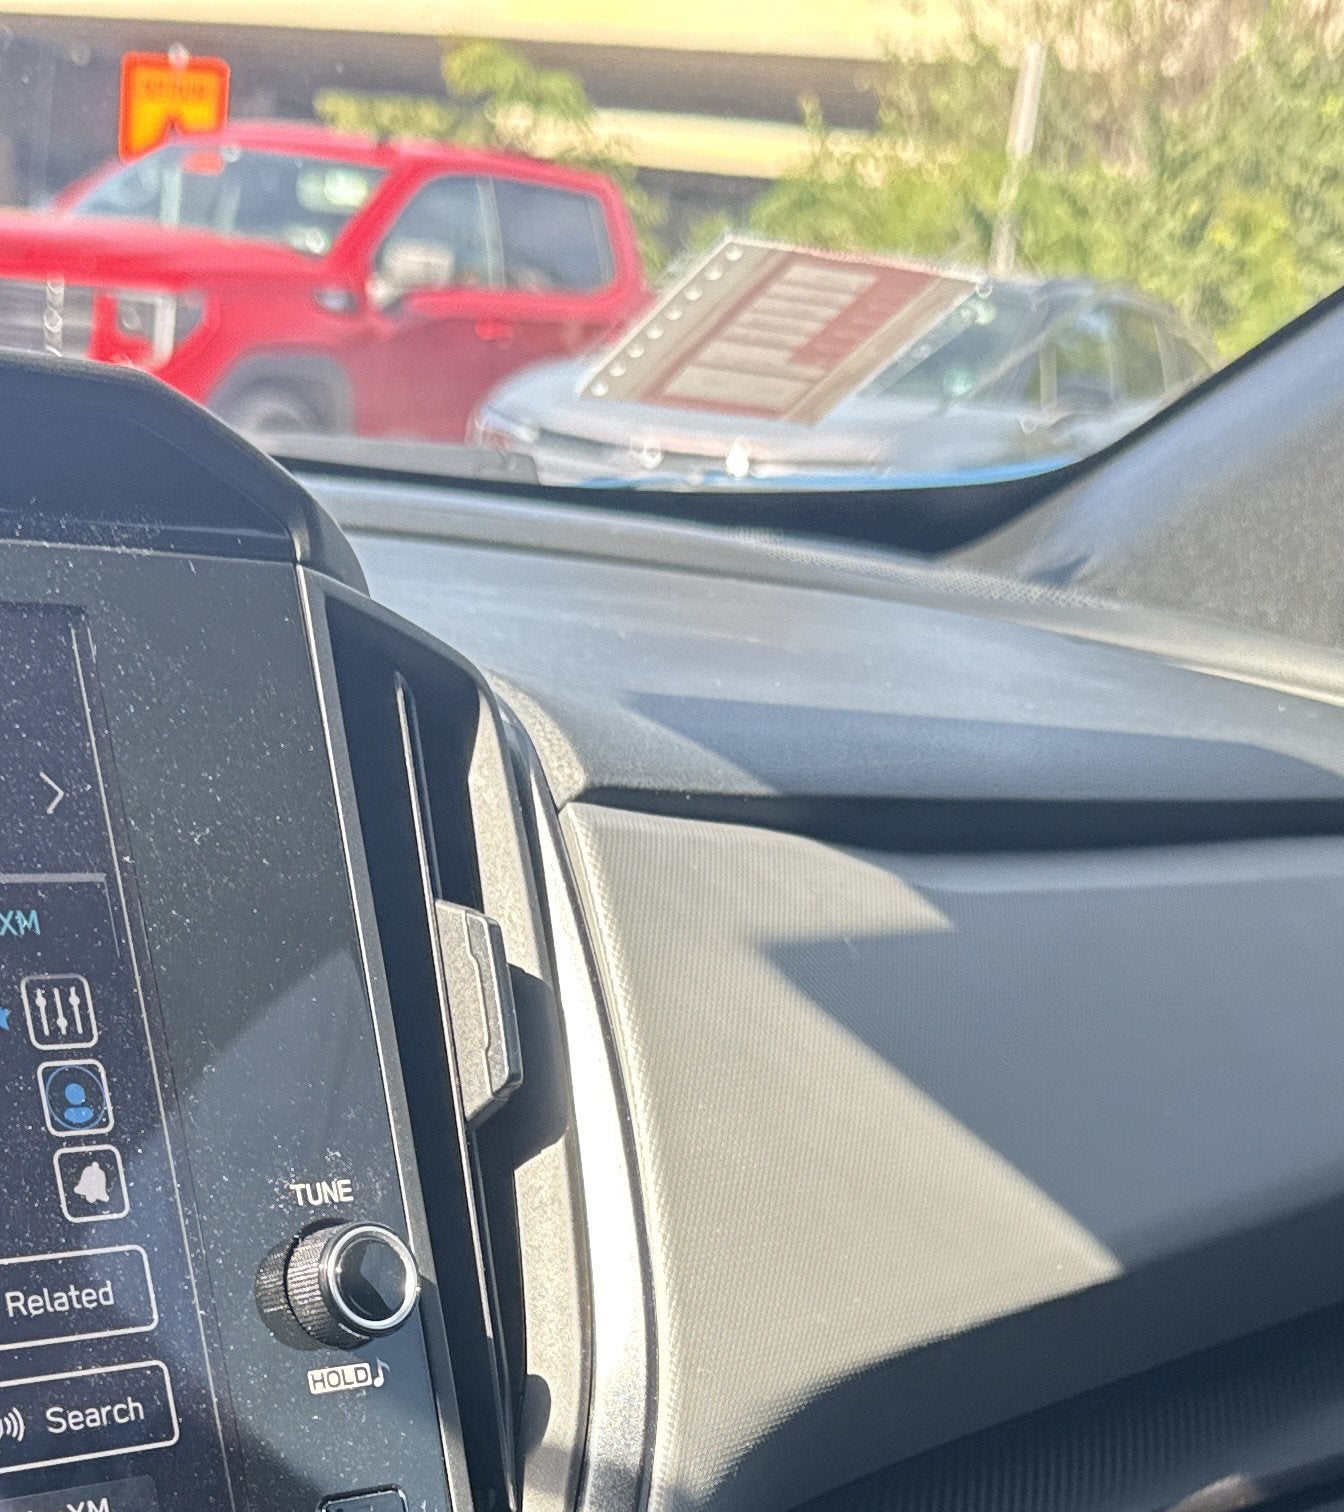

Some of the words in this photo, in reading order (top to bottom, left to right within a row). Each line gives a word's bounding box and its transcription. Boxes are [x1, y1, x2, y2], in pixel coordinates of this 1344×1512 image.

[290, 1179, 354, 1207] TUNE
[4, 1280, 115, 1319] Related
[311, 1364, 371, 1392] HOLD
[46, 1396, 145, 1435] Search
